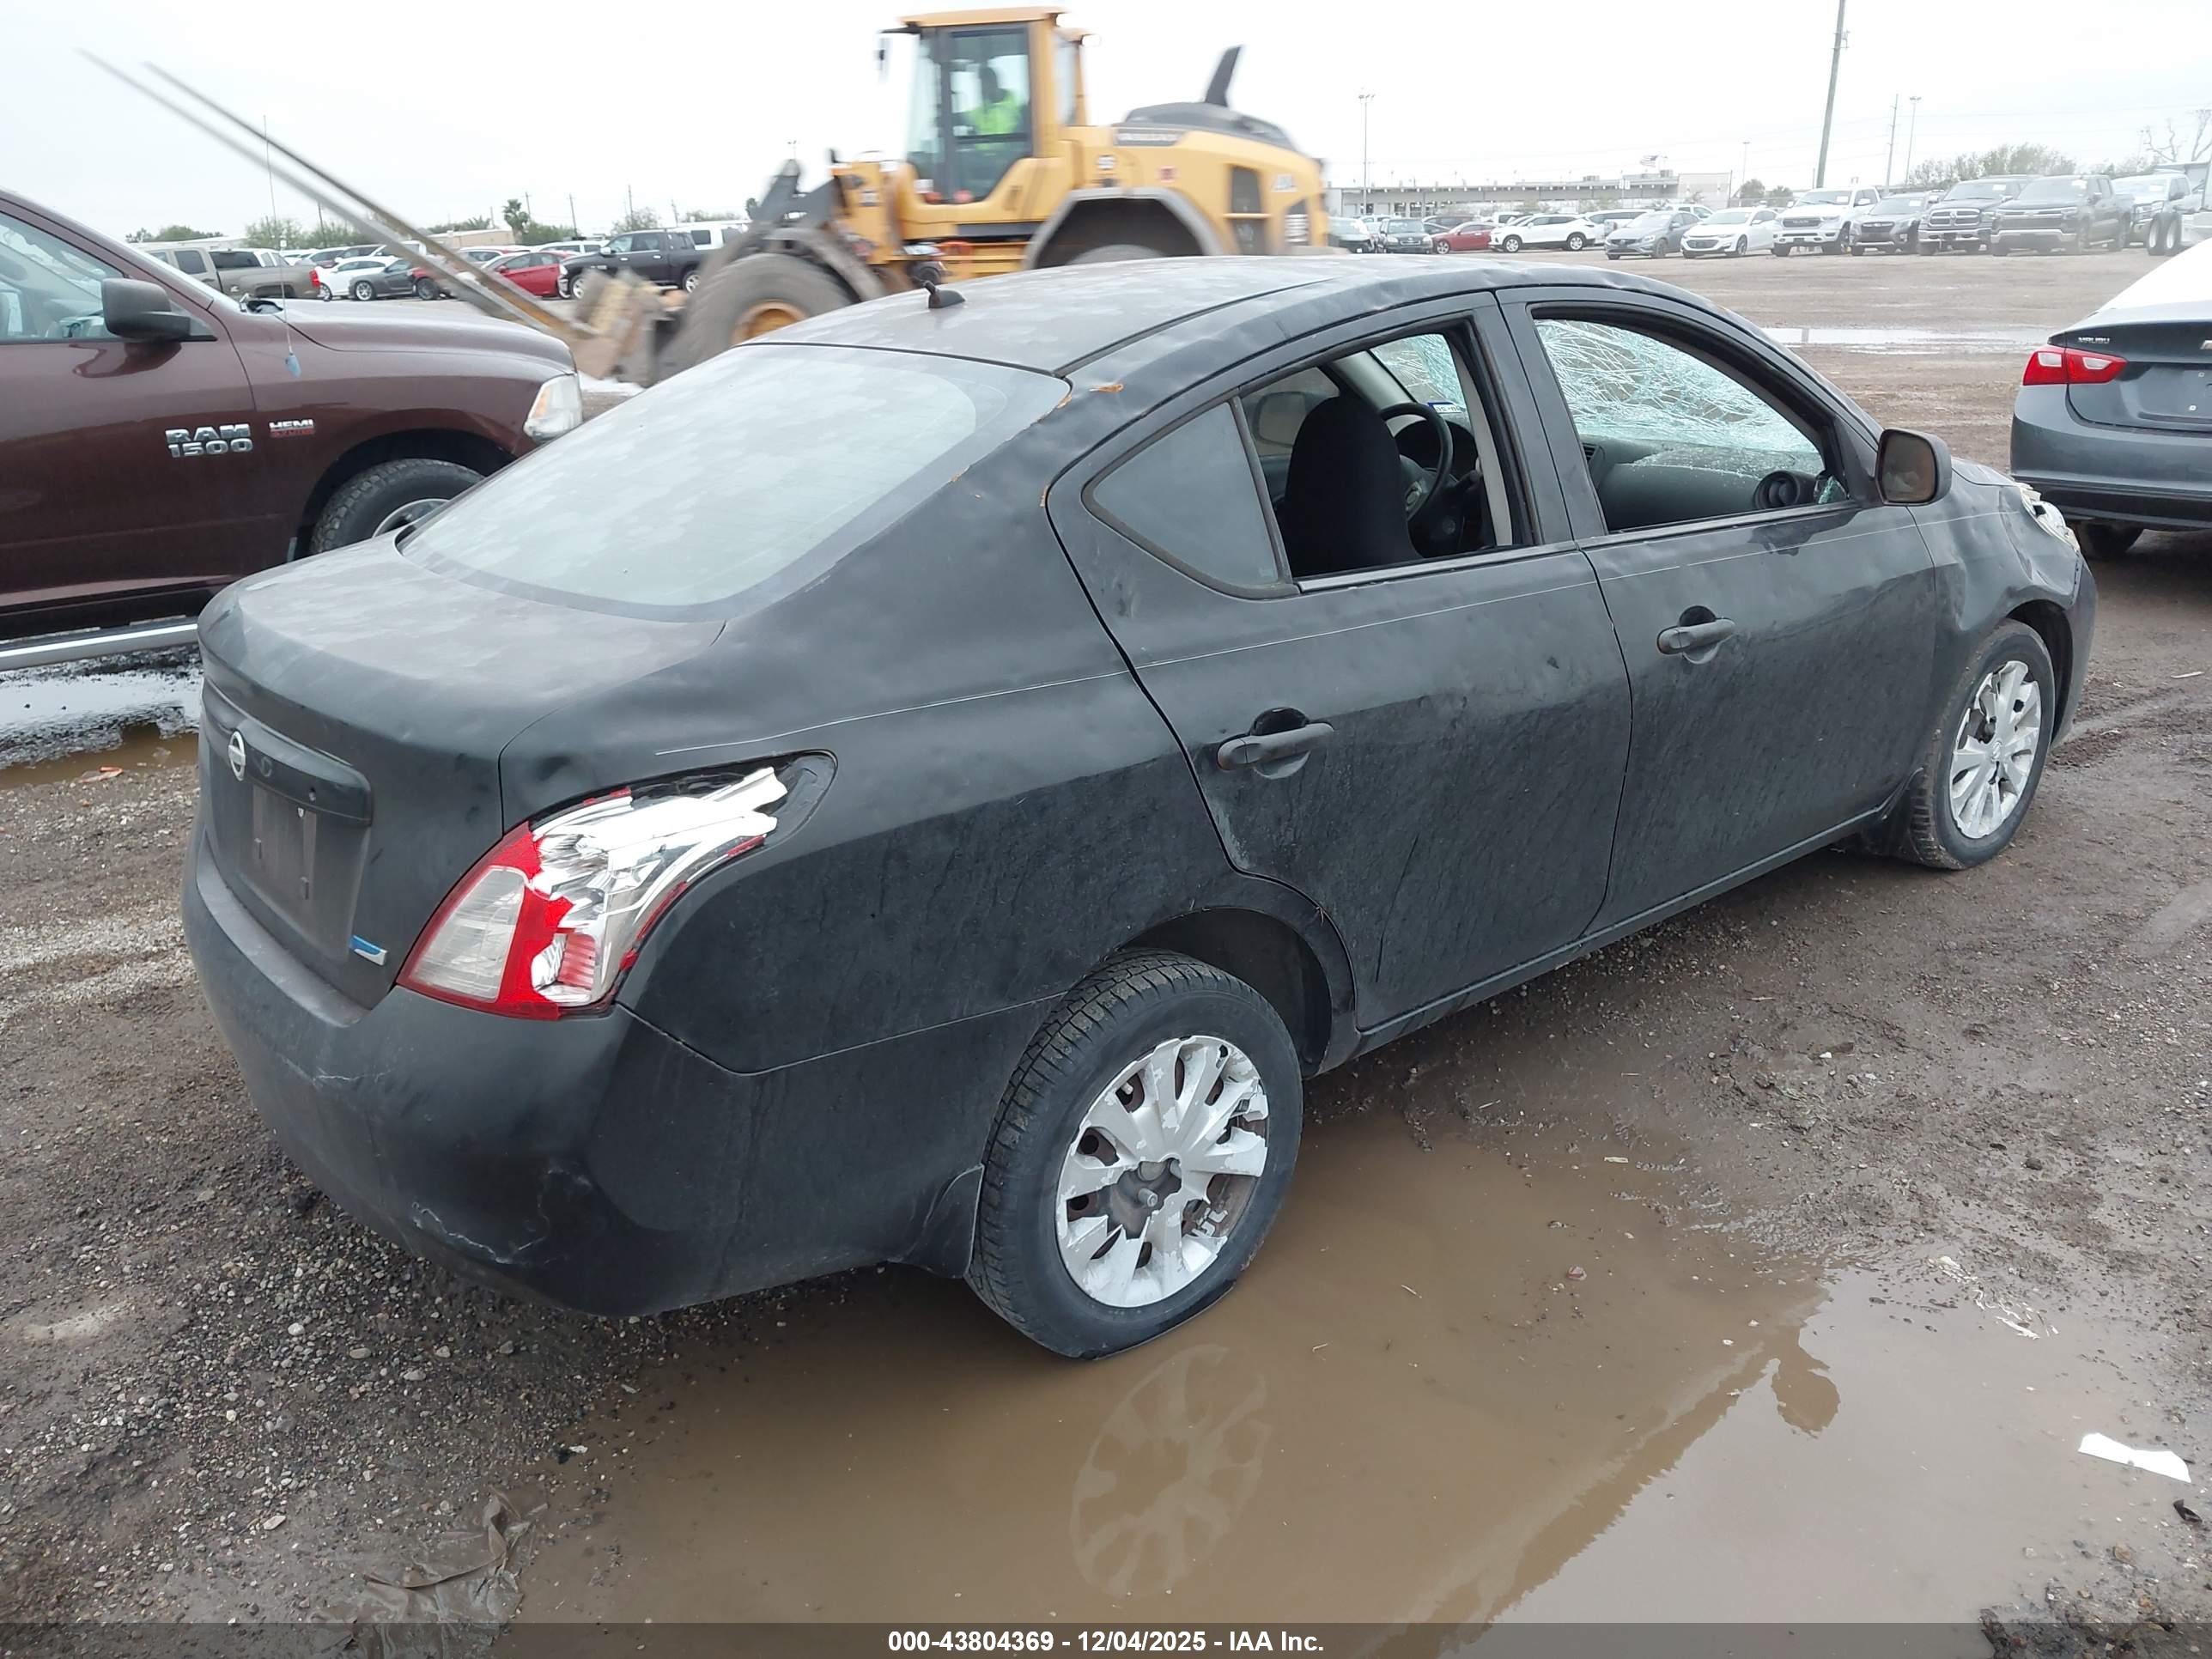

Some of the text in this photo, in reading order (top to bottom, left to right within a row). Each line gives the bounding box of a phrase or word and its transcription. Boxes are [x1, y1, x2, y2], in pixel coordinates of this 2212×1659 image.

[165, 423, 252, 442] RAM
[269, 418, 314, 429] HEMI
[168, 438, 253, 458] 1500
